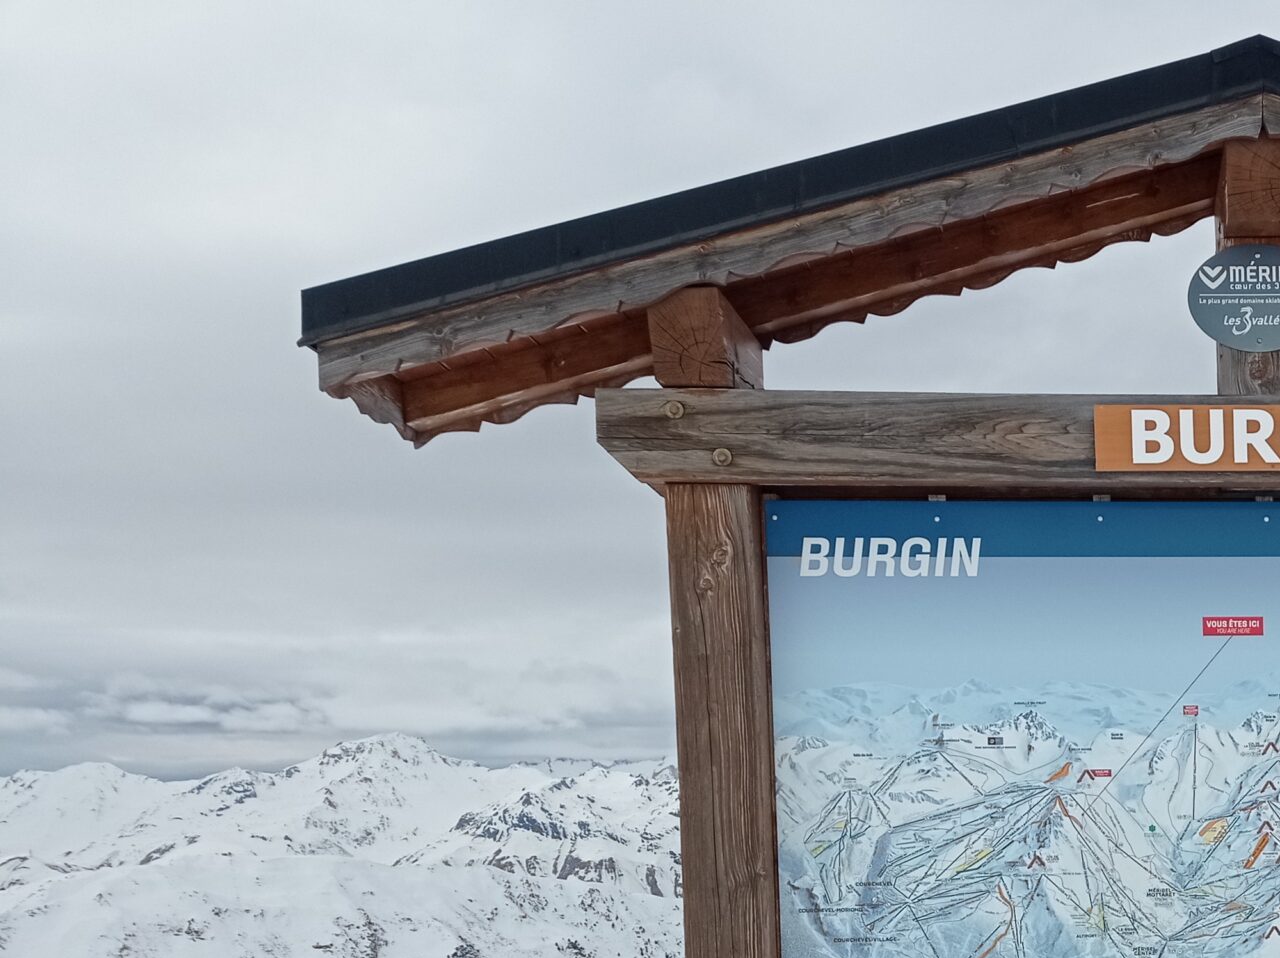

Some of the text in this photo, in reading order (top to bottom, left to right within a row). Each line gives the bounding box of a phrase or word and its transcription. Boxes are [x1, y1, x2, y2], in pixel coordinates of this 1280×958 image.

[1255, 282, 1271, 290] des
[1274, 282, 1280, 290] 3
[1223, 315, 1240, 326] les
[1232, 306, 1254, 336] 3
[800, 537, 982, 577] BURGIN
[1206, 619, 1260, 628] VOUS ÊTES ICI
